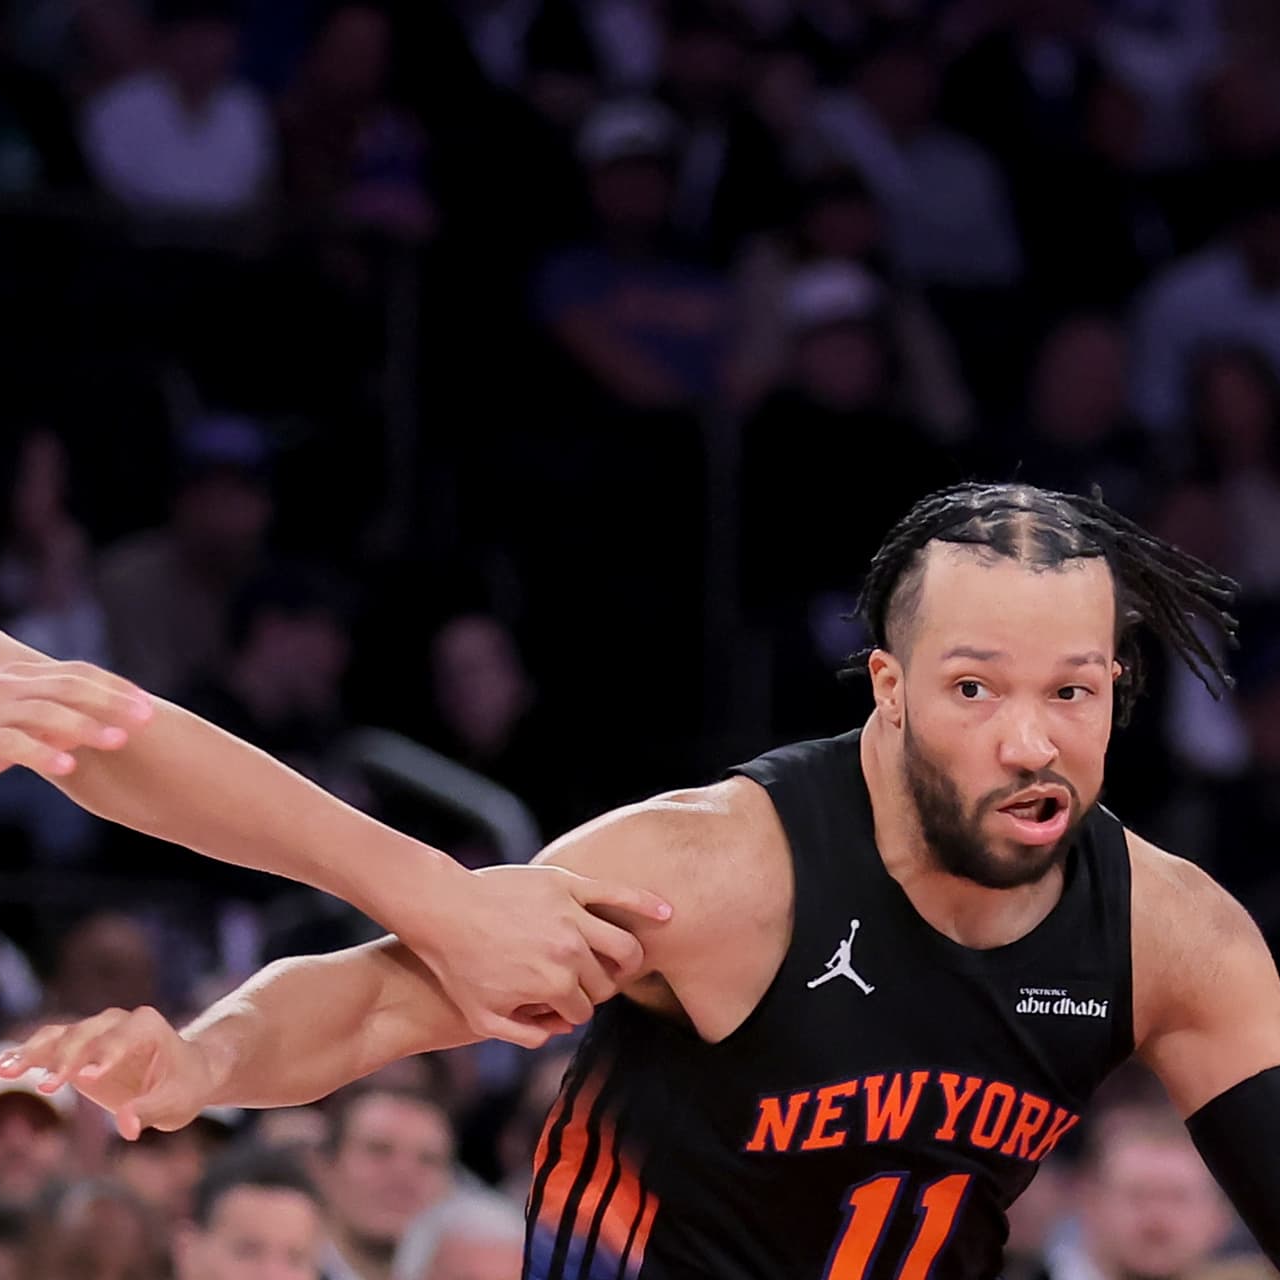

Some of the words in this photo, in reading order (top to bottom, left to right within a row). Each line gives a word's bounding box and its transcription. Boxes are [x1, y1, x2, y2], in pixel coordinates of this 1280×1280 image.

[1015, 996, 1051, 1015] abu
[1052, 998, 1109, 1018] dhabi
[745, 1069, 931, 1153] NEW
[933, 1069, 1082, 1163] YORK
